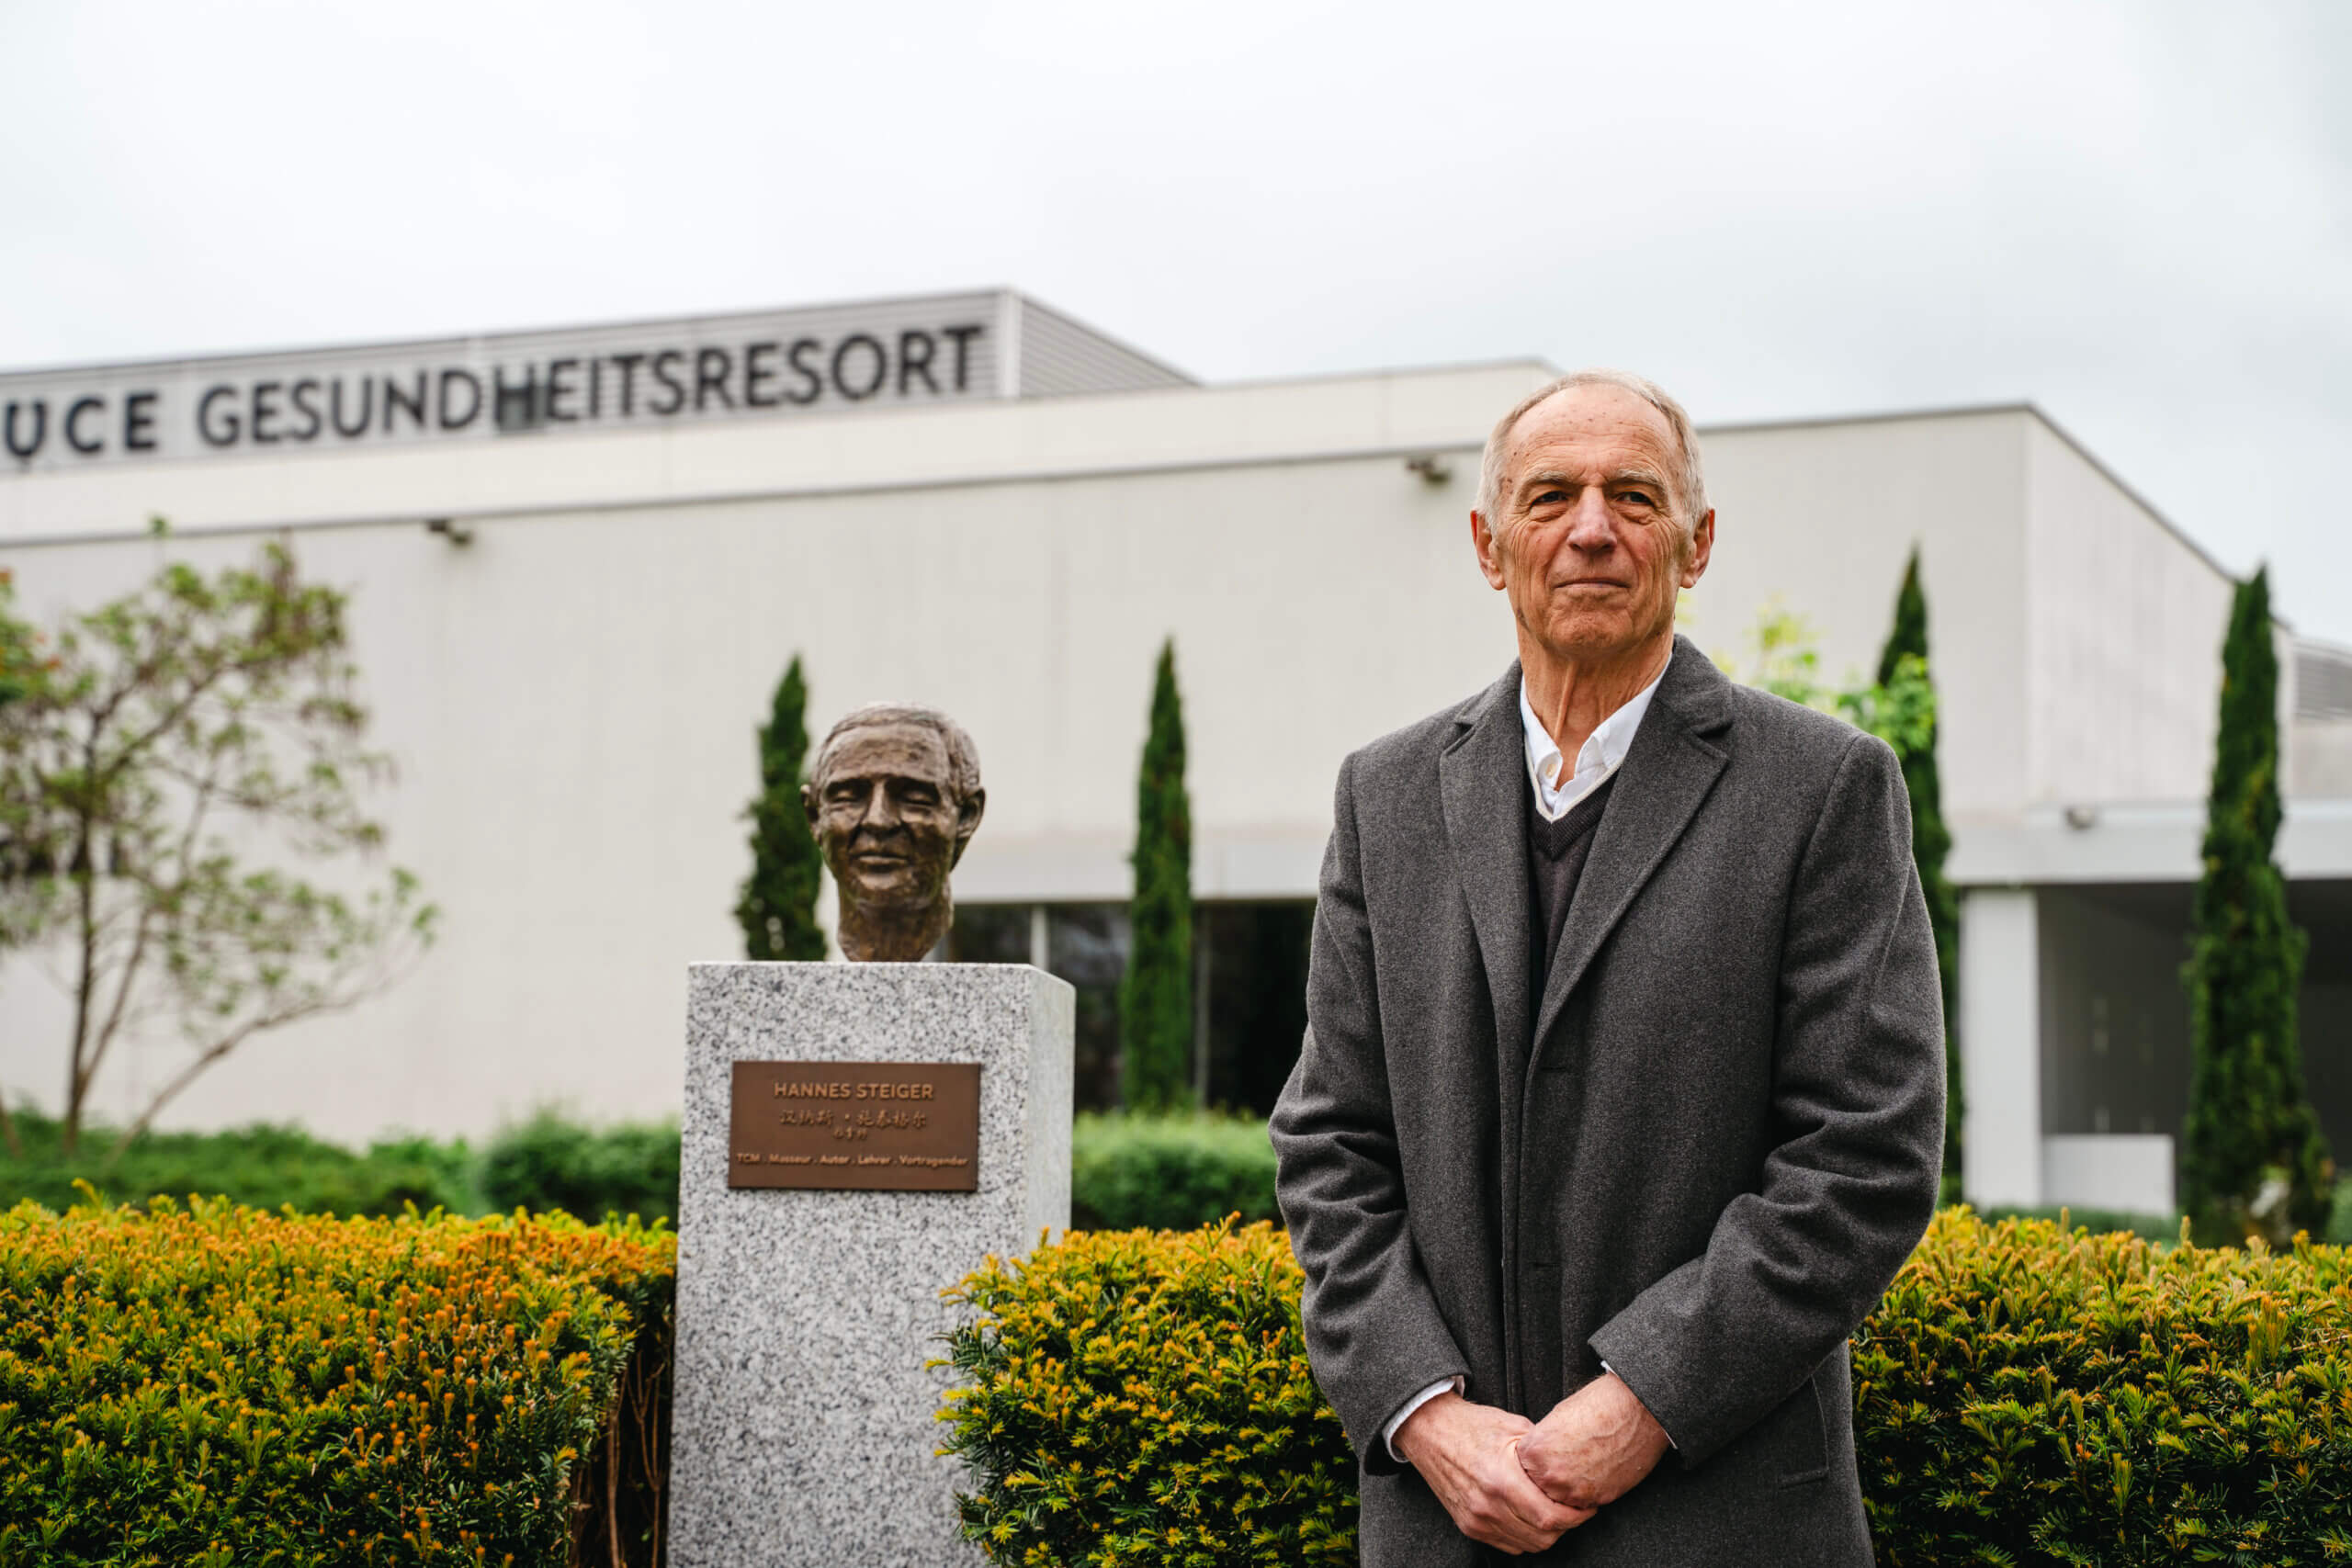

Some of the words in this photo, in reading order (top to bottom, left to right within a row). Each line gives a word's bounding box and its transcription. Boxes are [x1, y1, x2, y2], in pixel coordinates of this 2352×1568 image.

[197, 323, 983, 449] GESUNDHEITSRESORT
[774, 1082, 851, 1100] HANNES
[856, 1083, 933, 1100] STEIGER
[737, 1153, 761, 1164] TCM
[769, 1153, 812, 1165] Masseur
[820, 1155, 851, 1165] Autor
[858, 1155, 891, 1166] Lehrer
[899, 1155, 969, 1170] Vortragender
